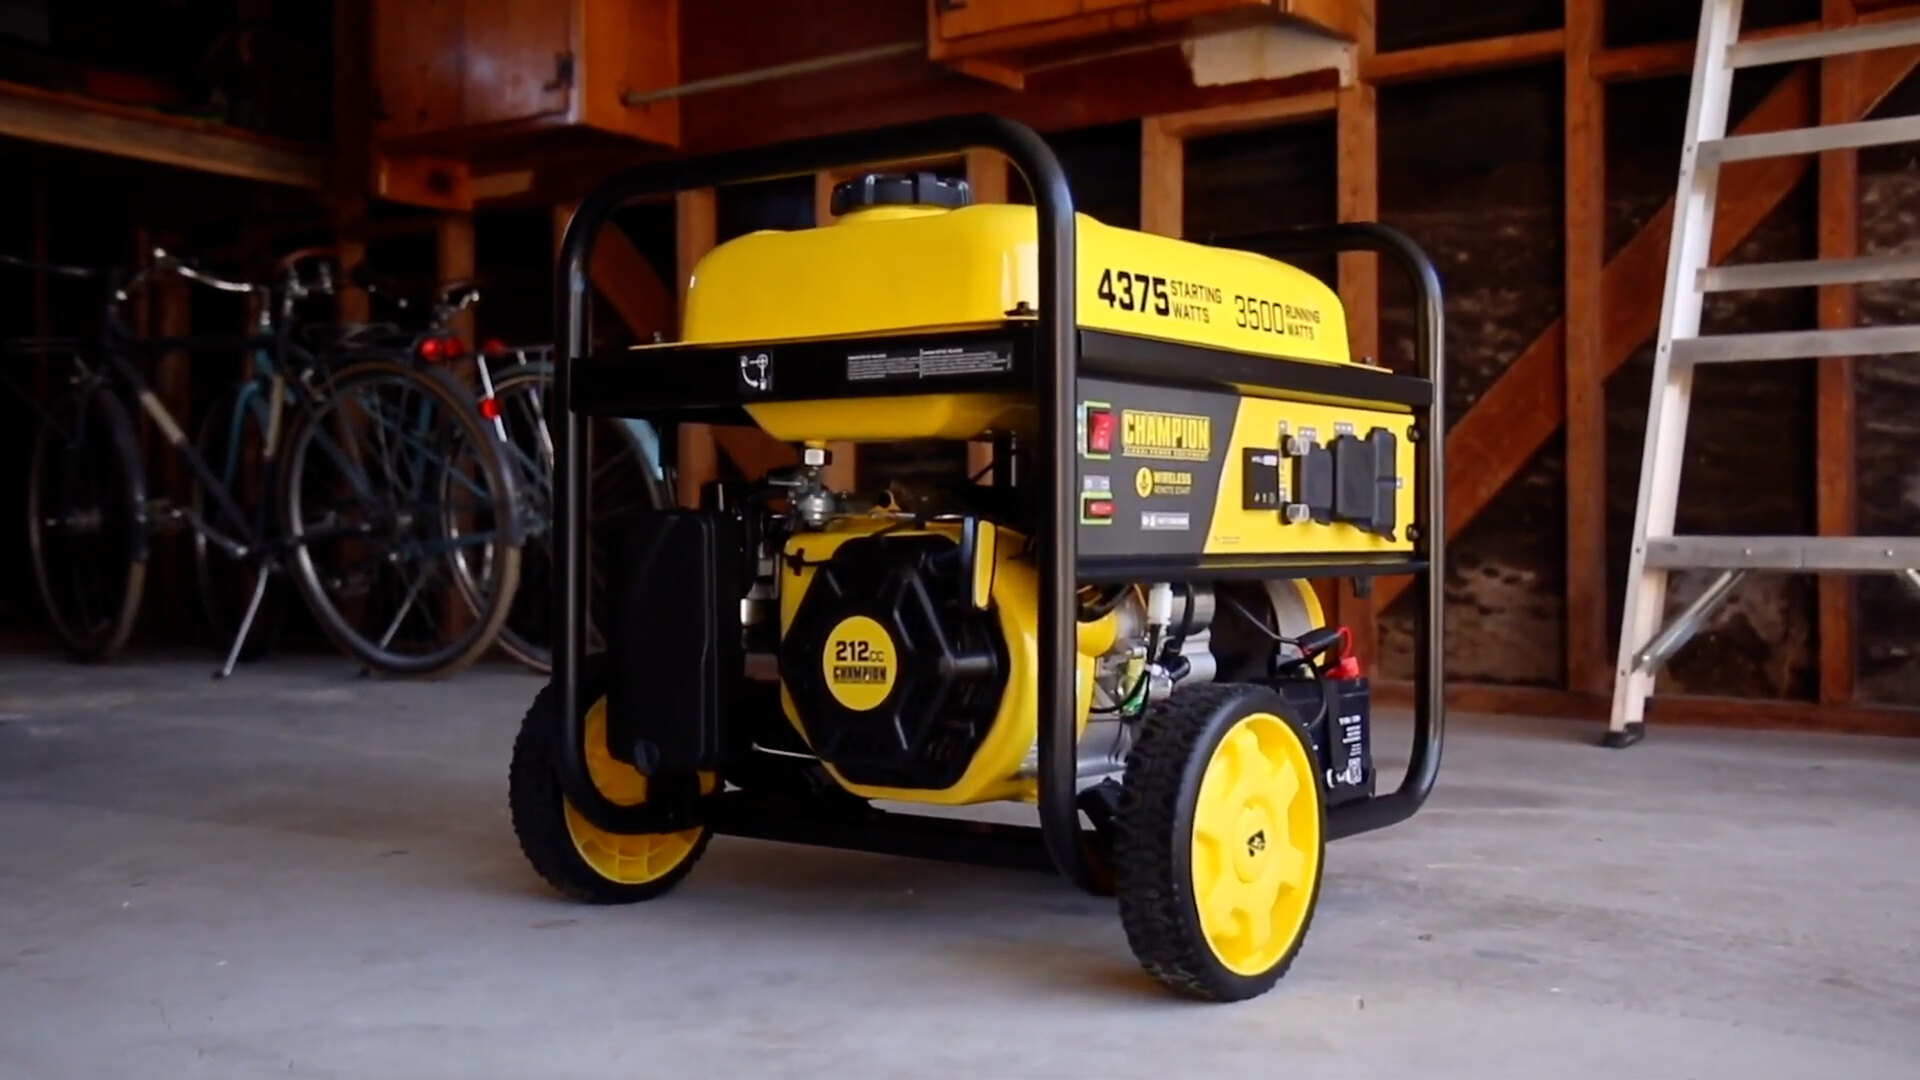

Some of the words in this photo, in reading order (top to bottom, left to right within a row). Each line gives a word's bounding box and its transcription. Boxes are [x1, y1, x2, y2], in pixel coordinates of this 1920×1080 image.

[1097, 268, 1170, 317] 4375
[1170, 280, 1222, 304] STARTING
[1172, 301, 1210, 324] WATTS
[1234, 295, 1284, 334] 3500
[1285, 304, 1321, 324] RUNNING
[1286, 322, 1315, 340] WATTS
[1123, 413, 1209, 449] CHAMPION
[833, 665, 887, 681] CHAMPION
